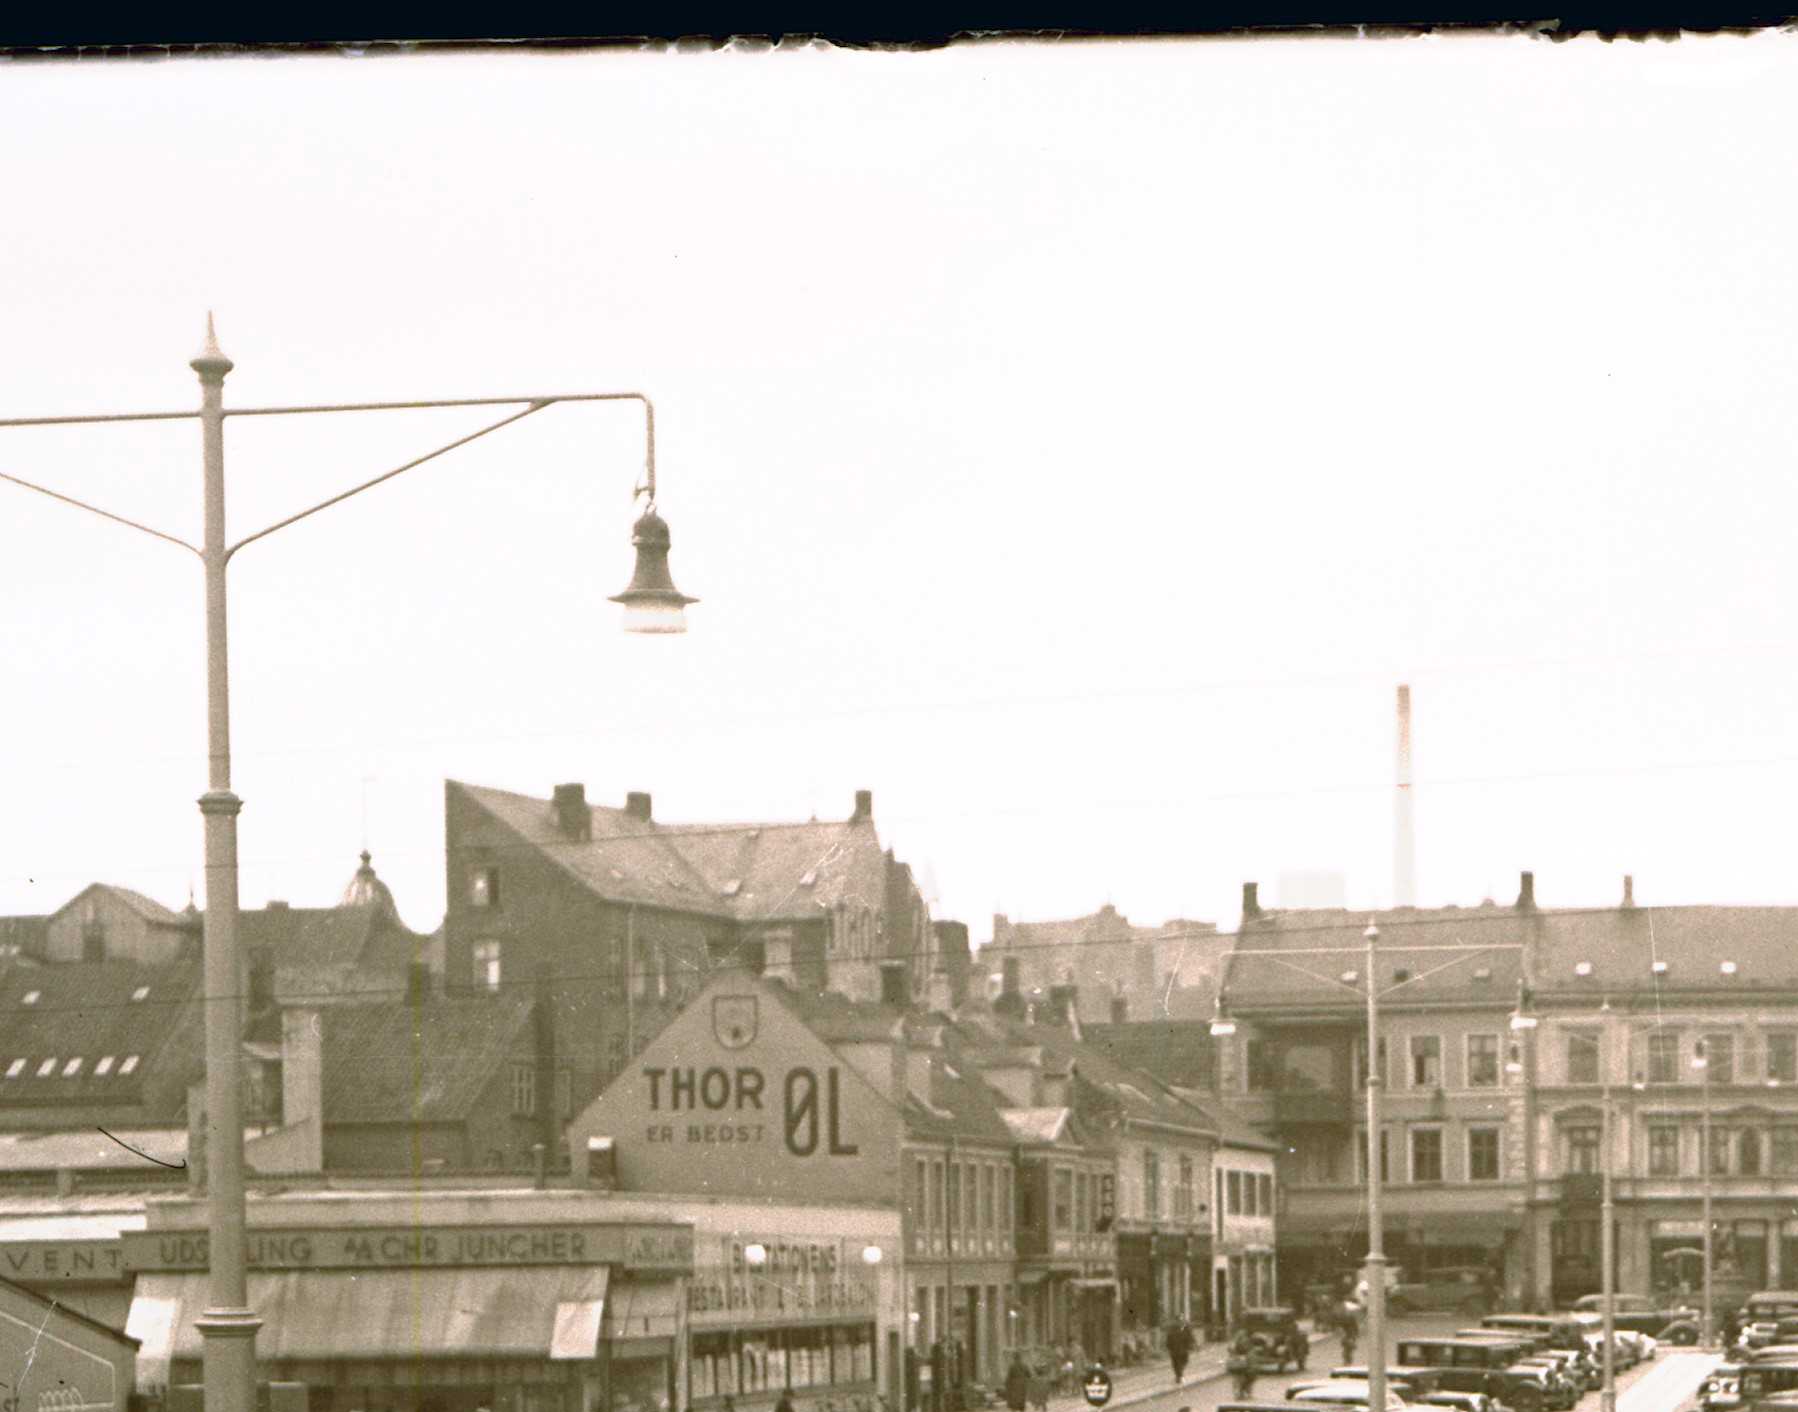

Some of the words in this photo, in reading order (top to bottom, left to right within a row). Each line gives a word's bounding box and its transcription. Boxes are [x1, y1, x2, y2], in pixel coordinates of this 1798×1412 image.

[642, 1067, 766, 1111] THOR
[784, 1067, 859, 1157] ØL
[647, 1125, 674, 1143] ER
[687, 1125, 766, 1143] BEDST
[159, 1236, 313, 1264] UDSLING
[452, 1231, 586, 1261] JUNCHER
